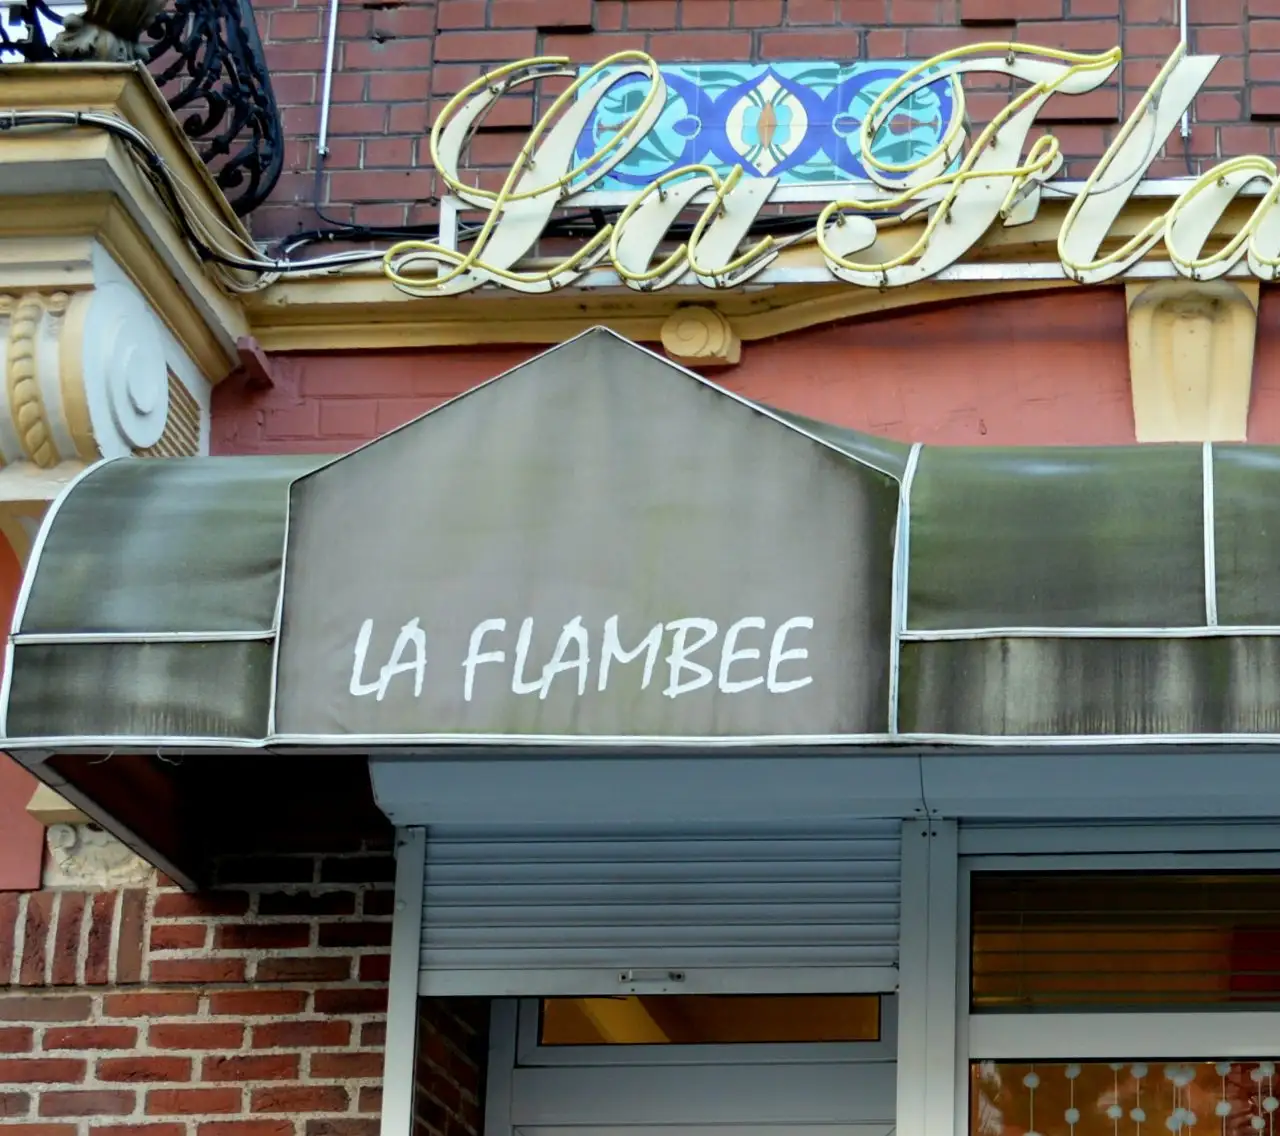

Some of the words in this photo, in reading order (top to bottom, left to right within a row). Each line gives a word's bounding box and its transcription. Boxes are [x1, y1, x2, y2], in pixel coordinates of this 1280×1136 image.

[382, 49, 778, 296] La
[349, 616, 428, 701] LA
[461, 614, 814, 701] FLAMBEE
